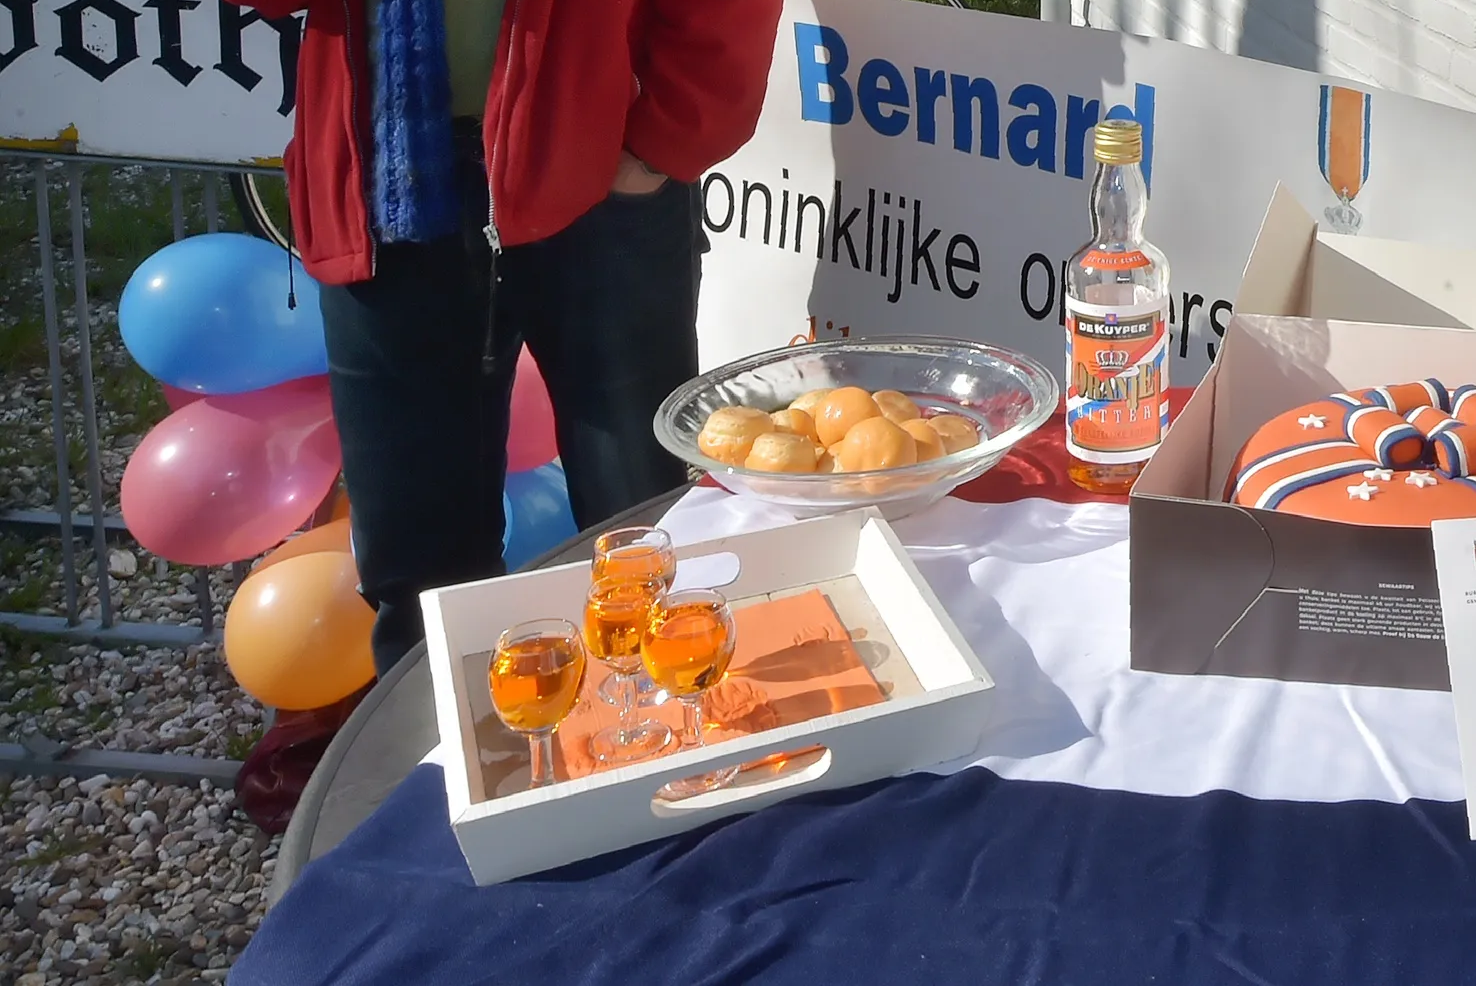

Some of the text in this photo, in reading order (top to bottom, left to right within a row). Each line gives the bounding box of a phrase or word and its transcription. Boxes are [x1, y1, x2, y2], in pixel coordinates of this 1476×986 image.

[793, 21, 1156, 201] Bernard
[702, 167, 980, 301] oninklijke
[1075, 361, 1155, 411] ORANJE
[1077, 405, 1152, 424] BITTER
